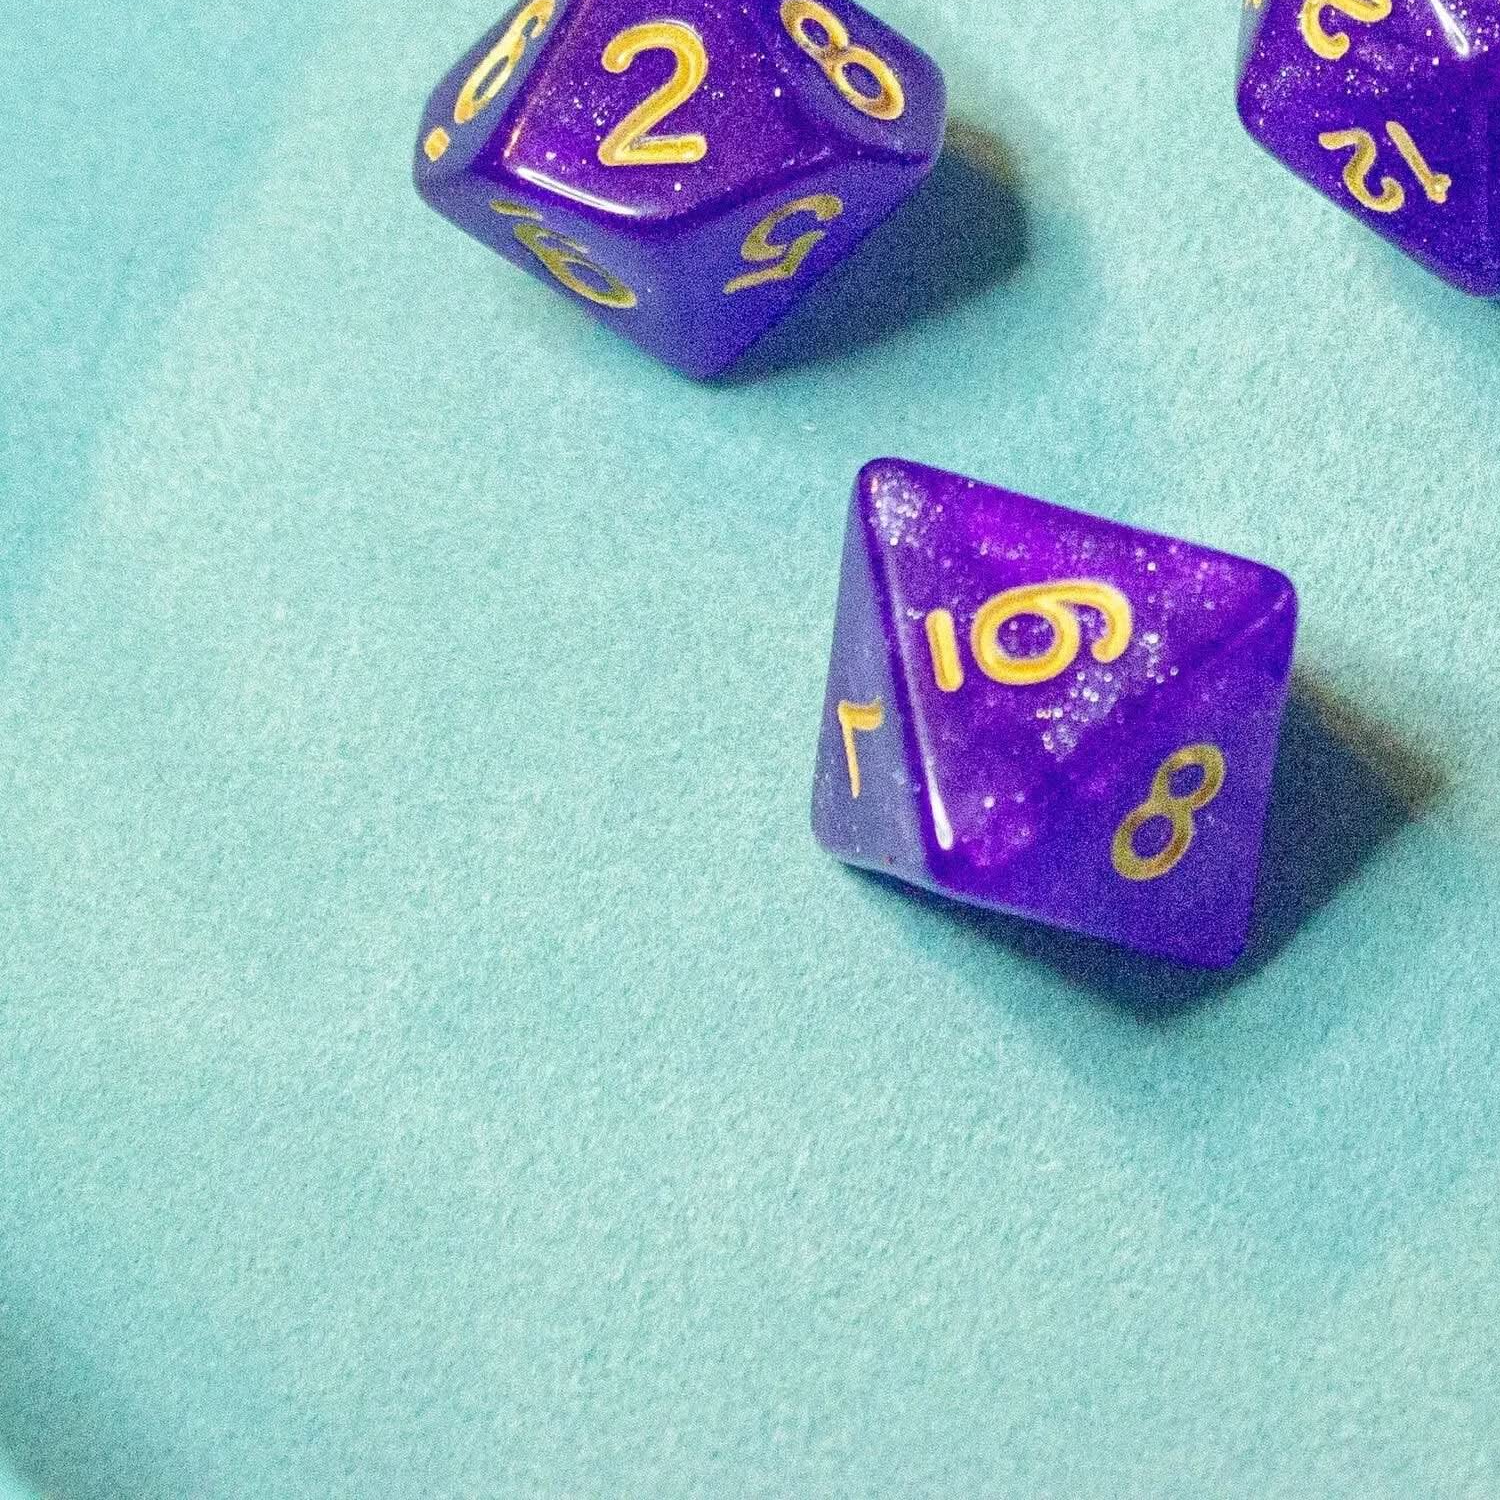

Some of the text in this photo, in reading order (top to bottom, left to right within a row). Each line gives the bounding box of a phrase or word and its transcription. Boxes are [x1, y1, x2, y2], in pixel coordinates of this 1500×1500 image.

[597, 20, 708, 166] 2
[1317, 120, 1452, 214] 12
[722, 193, 844, 296] 5
[1111, 742, 1227, 880] 8
